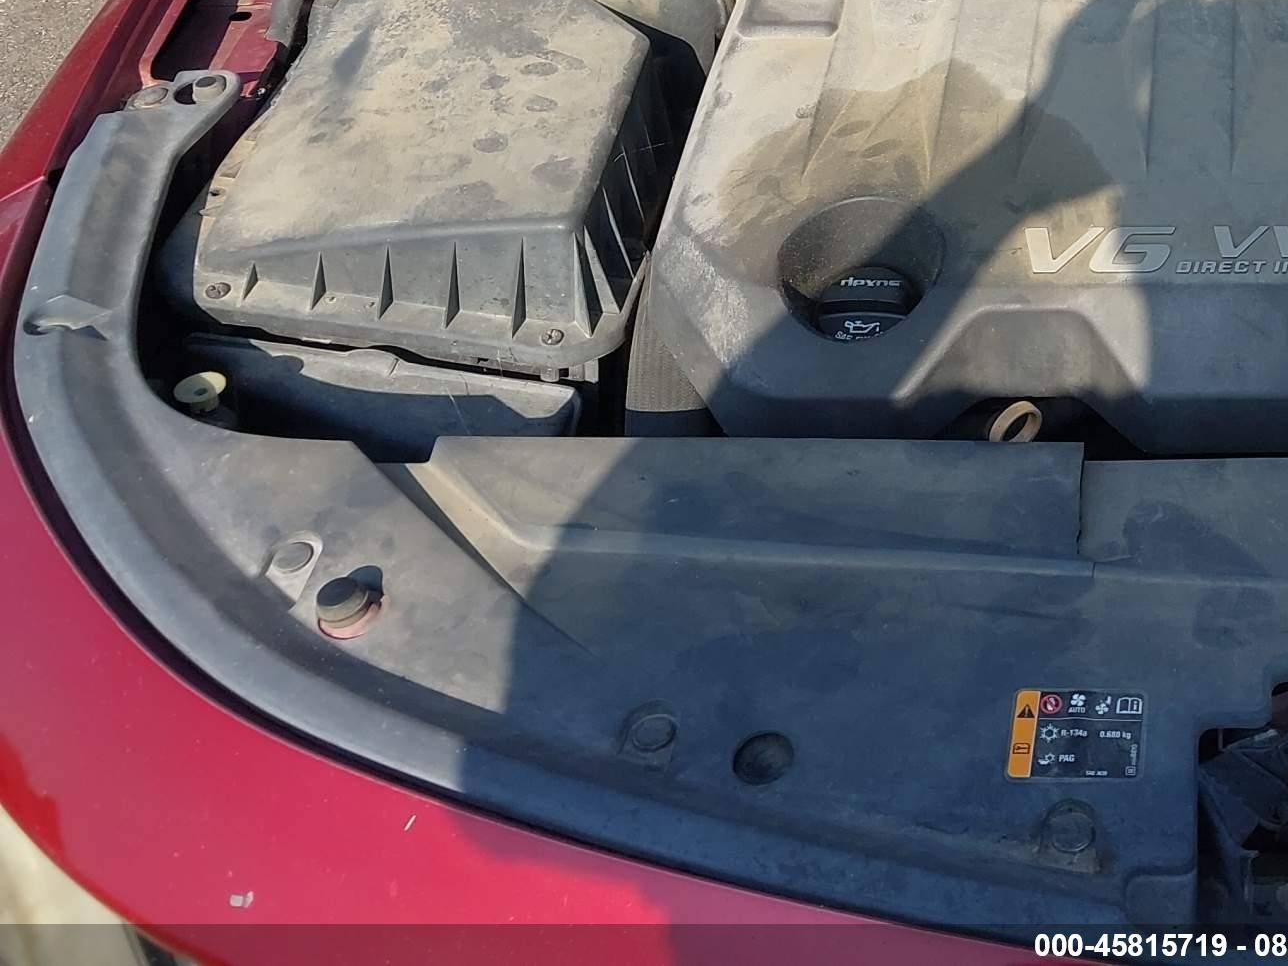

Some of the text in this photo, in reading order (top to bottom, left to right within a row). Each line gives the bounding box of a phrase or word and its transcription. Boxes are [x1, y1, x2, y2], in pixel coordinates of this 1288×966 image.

[1025, 226, 1176, 274] V6
[1175, 260, 1267, 274] DIRECT
[1122, 731, 1131, 740] kg
[1058, 754, 1075, 762] PAG
